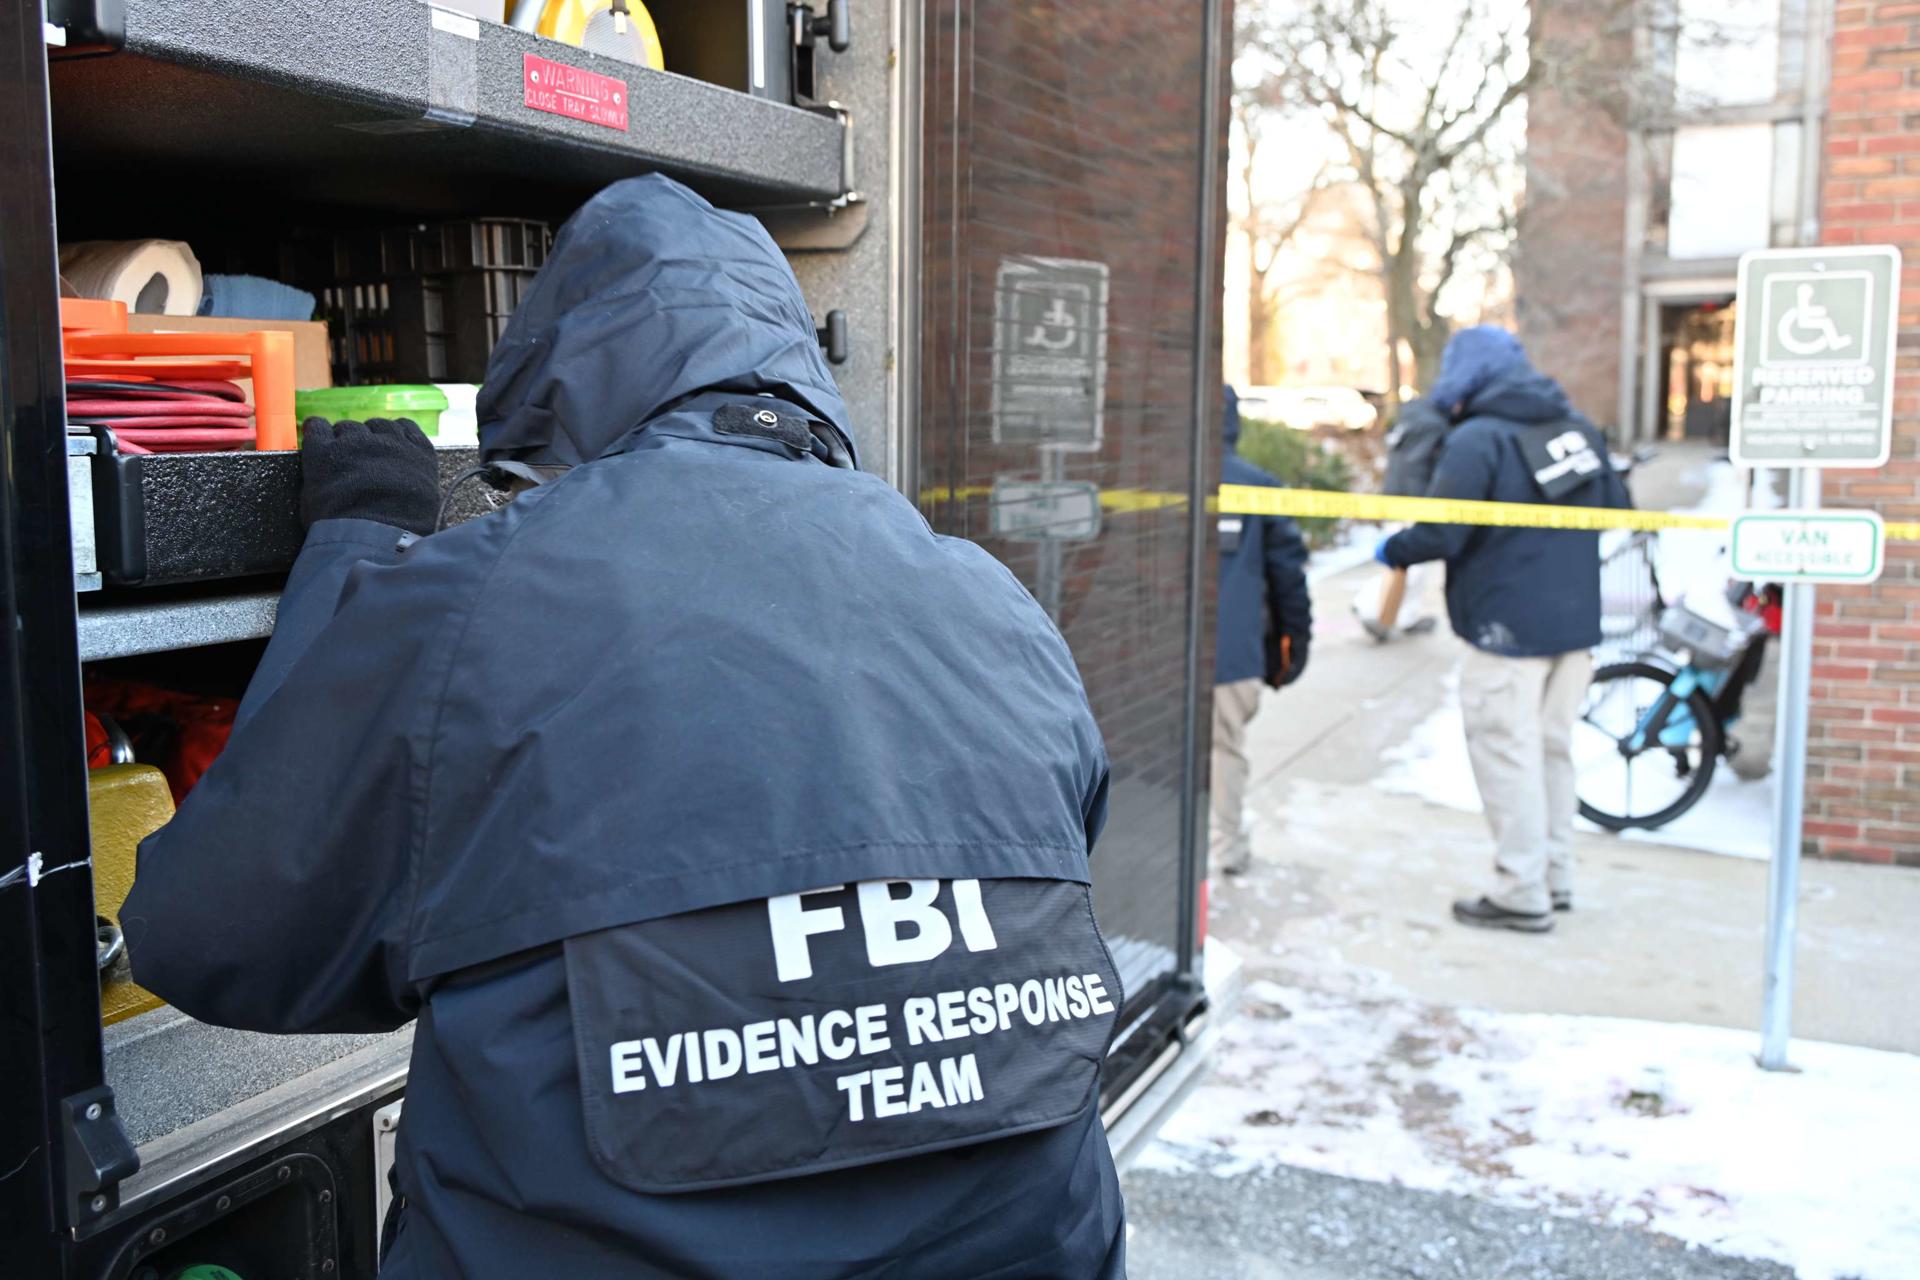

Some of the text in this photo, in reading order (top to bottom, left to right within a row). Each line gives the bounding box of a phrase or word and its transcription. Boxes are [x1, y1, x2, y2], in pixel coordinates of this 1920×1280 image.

[542, 64, 609, 101] WARNING
[526, 88, 625, 125] CLOSE TRAY SLOWLY
[1752, 366, 1876, 386] RESERVED
[1760, 386, 1865, 405] PARKING
[1781, 528, 1830, 546] VAN
[767, 879, 998, 982] FBI
[610, 974, 1116, 1094] EVIDENCE RESPONSE
[837, 1054, 984, 1122] TEAM
